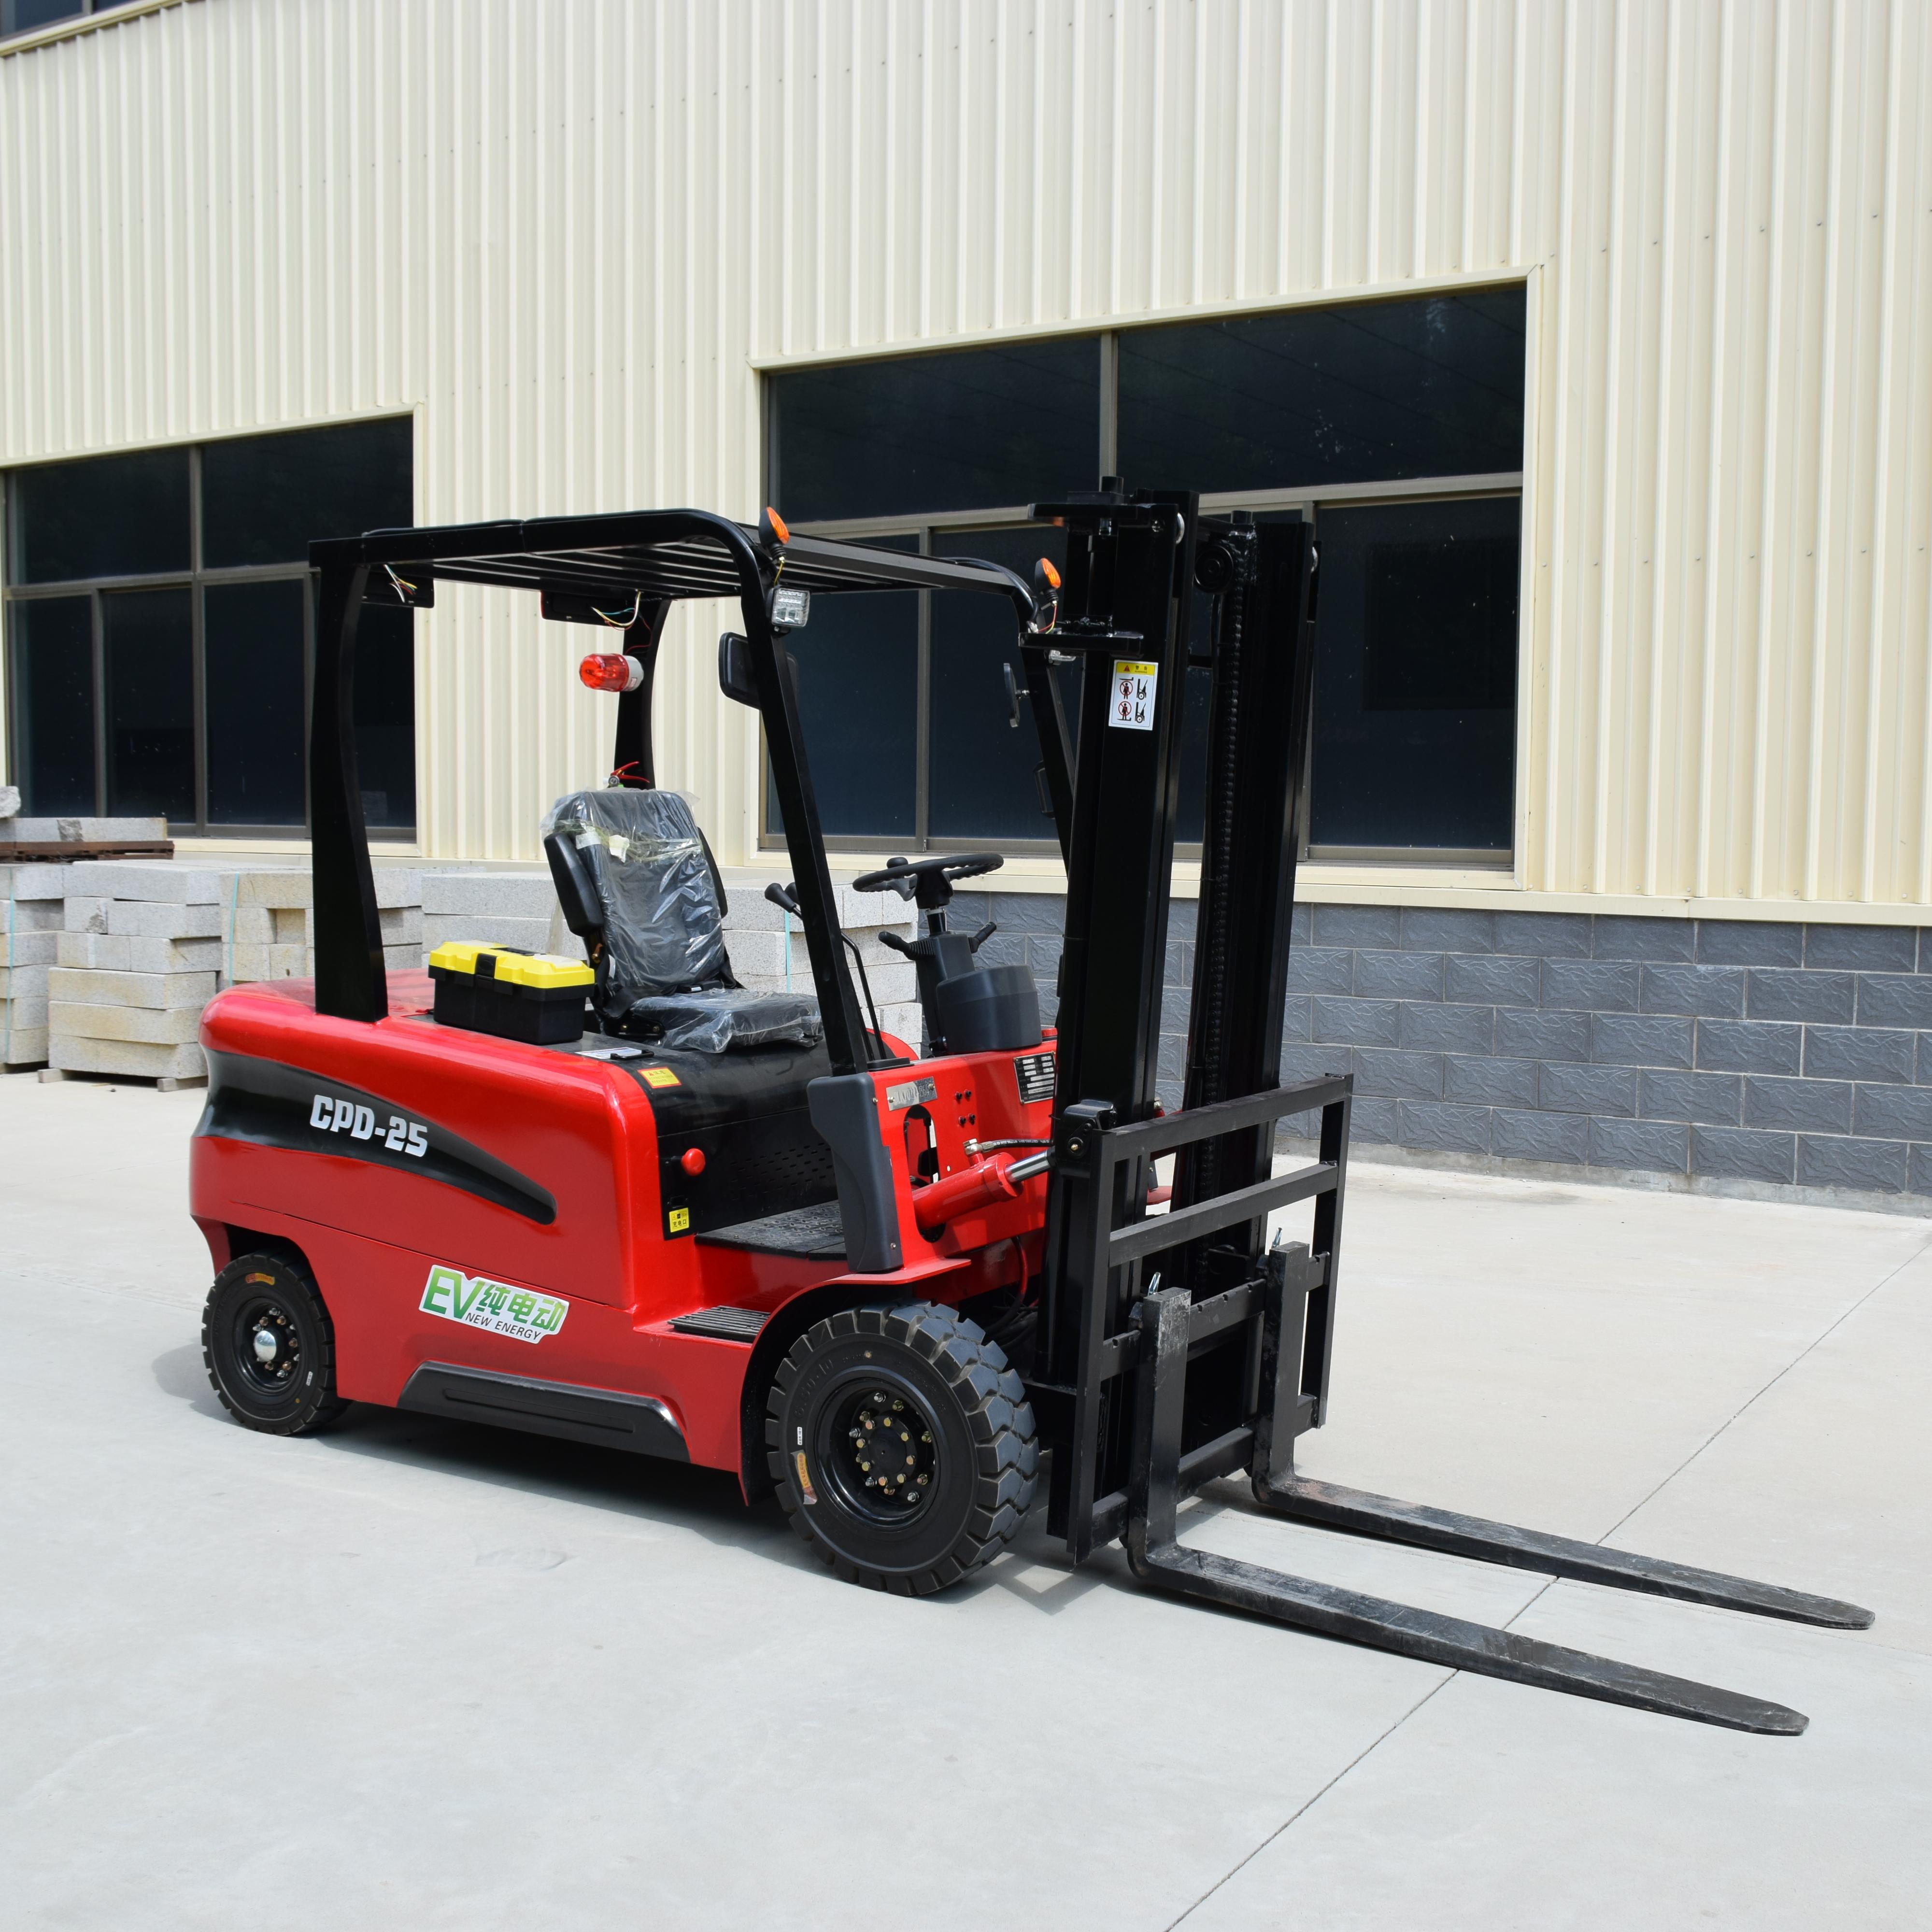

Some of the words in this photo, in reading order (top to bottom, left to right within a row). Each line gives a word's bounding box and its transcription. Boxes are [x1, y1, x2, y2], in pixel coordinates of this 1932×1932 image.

[310, 1094, 428, 1157] CPD-25
[423, 1267, 485, 1320] EV
[475, 1284, 566, 1332] 纯电动
[465, 1312, 492, 1326] NEW
[495, 1321, 541, 1340] ENERGY
